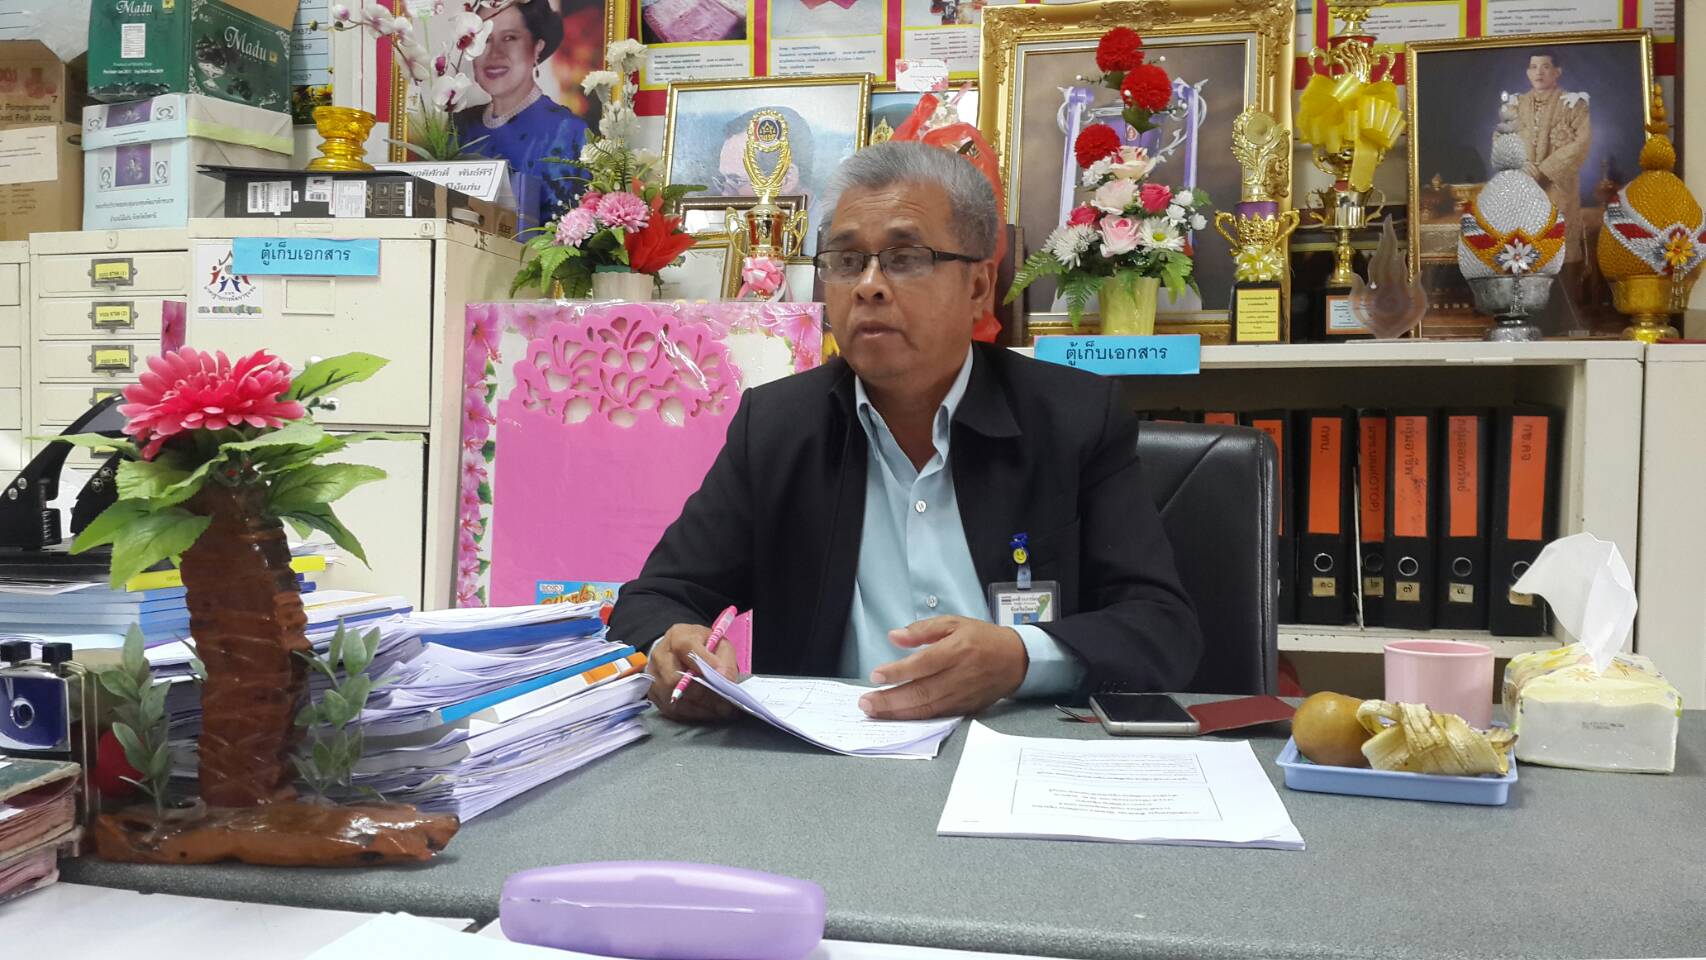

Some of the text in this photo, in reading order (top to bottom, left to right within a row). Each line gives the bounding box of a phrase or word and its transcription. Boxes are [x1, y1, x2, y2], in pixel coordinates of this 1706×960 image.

[116, 0, 152, 14] Madu
[224, 26, 266, 61] Madu
[261, 241, 351, 266] ตู้เก็บเอกสาร
[1065, 340, 1168, 365] ตู้เก็บเอกสาร
